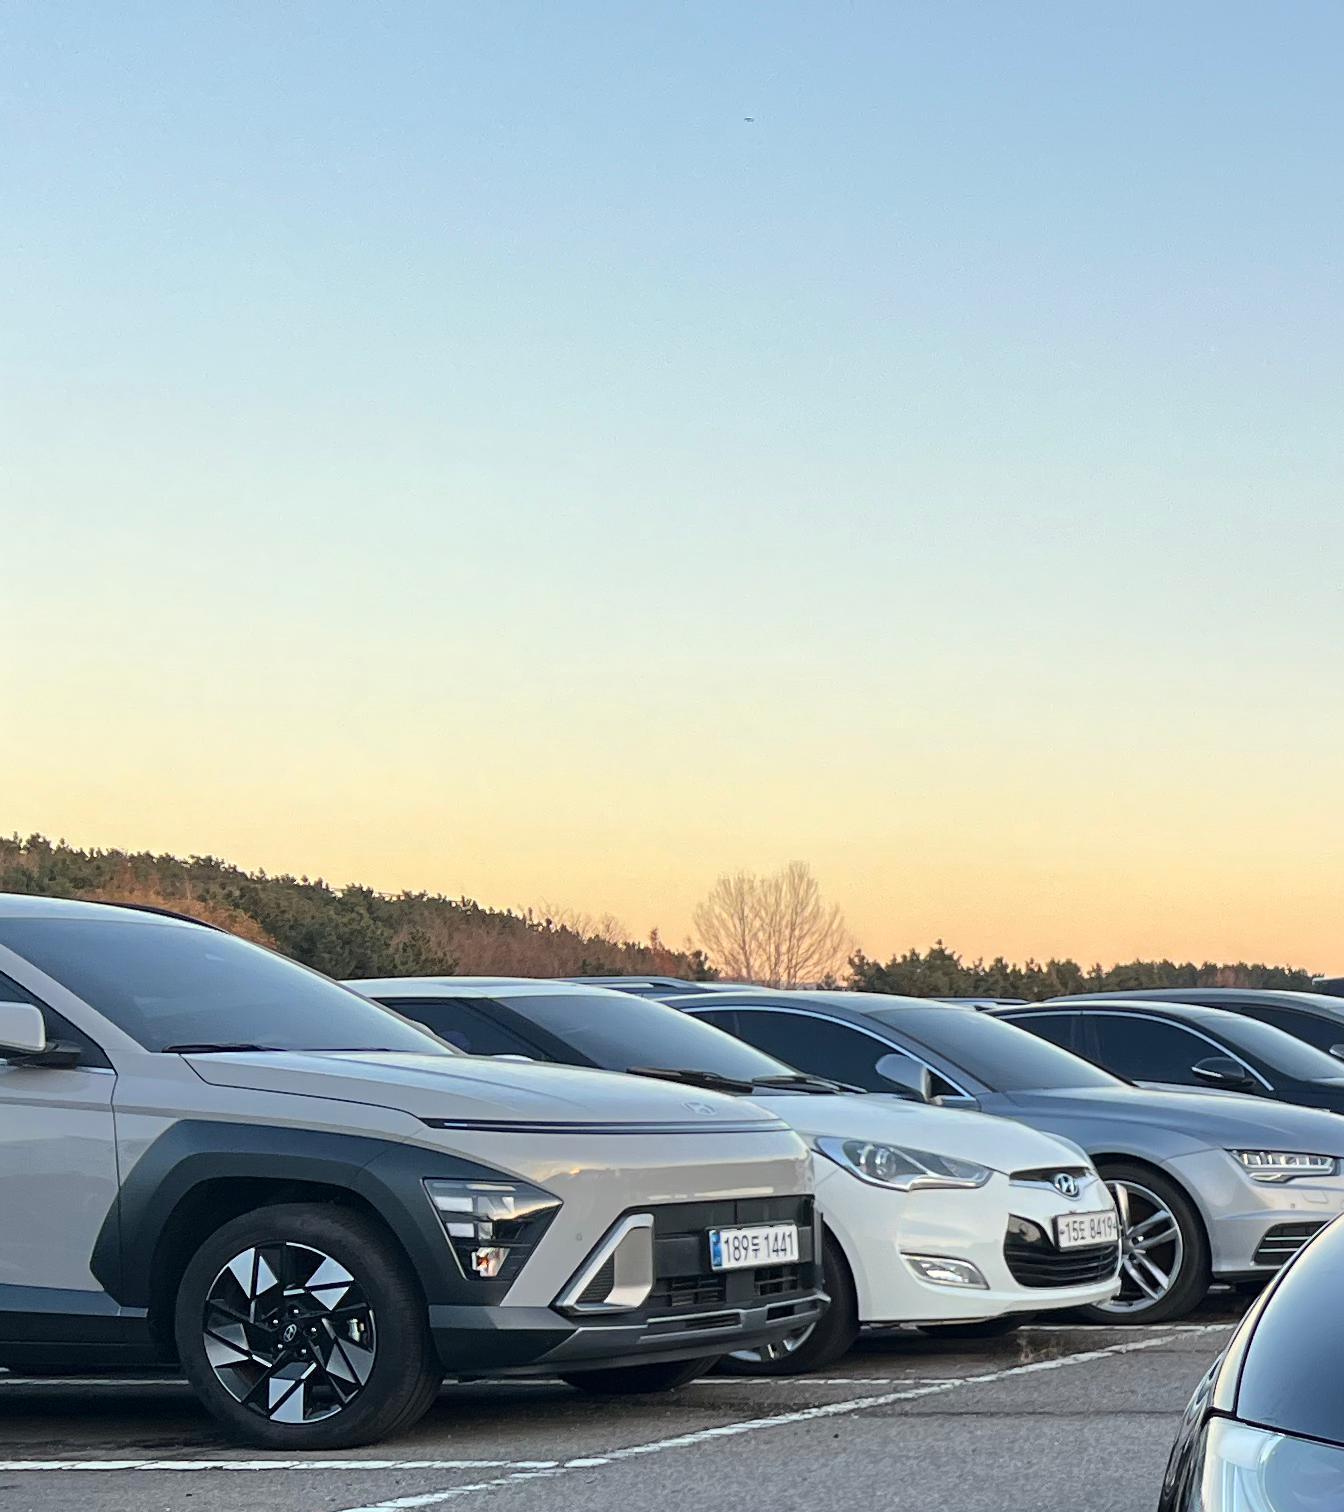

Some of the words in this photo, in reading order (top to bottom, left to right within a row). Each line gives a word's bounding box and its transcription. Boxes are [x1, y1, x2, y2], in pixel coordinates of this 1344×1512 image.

[1090, 1216, 1113, 1240] 8419
[724, 1234, 761, 1263] 189두
[764, 1231, 794, 1258] 1441
